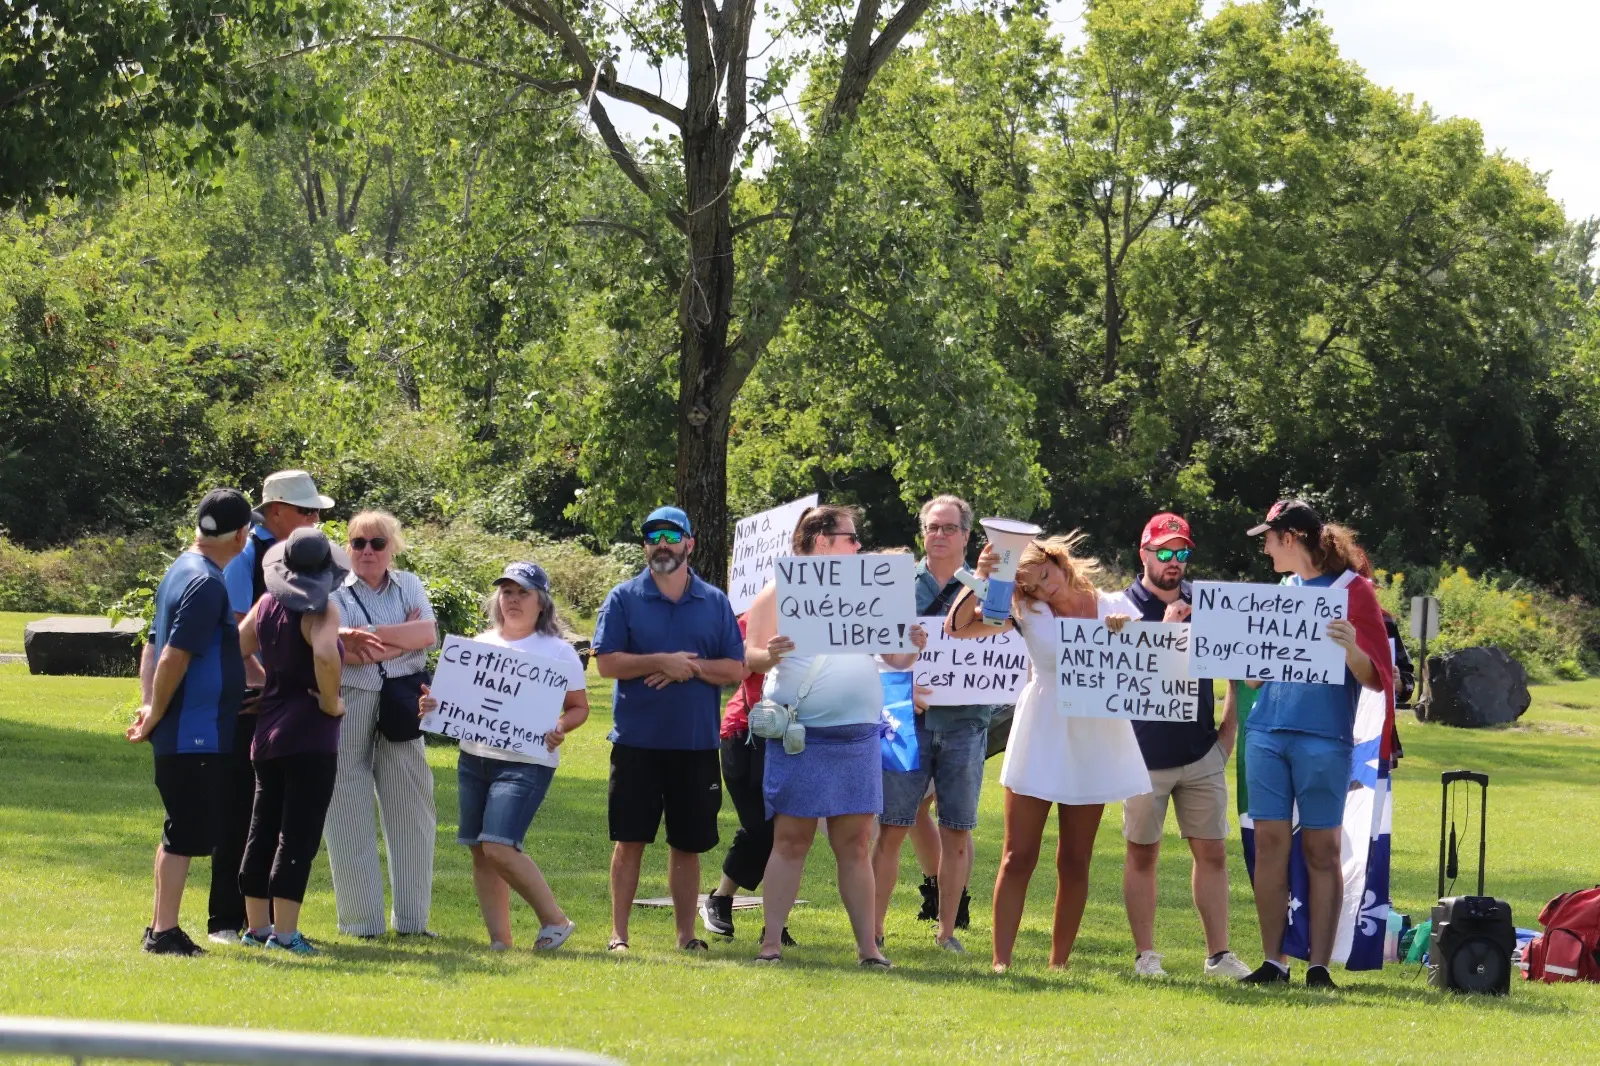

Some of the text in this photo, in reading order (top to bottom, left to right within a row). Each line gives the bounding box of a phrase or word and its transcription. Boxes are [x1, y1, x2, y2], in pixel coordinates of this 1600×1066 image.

[778, 560, 841, 586] VIVE
[1314, 596, 1343, 620] Pas
[1060, 621, 1086, 644] LA
[1247, 615, 1321, 641] HALAL
[983, 650, 1027, 671] HALAL
[1060, 647, 1159, 673] ANIMALE
[1195, 636, 1312, 662] Boycottez
[443, 644, 568, 691] Certification
[1246, 664, 1274, 680] Le
[473, 671, 521, 697] Halal
[1116, 673, 1152, 696] PAS
[438, 700, 546, 747] Financement
[440, 721, 524, 754] Islamiste
